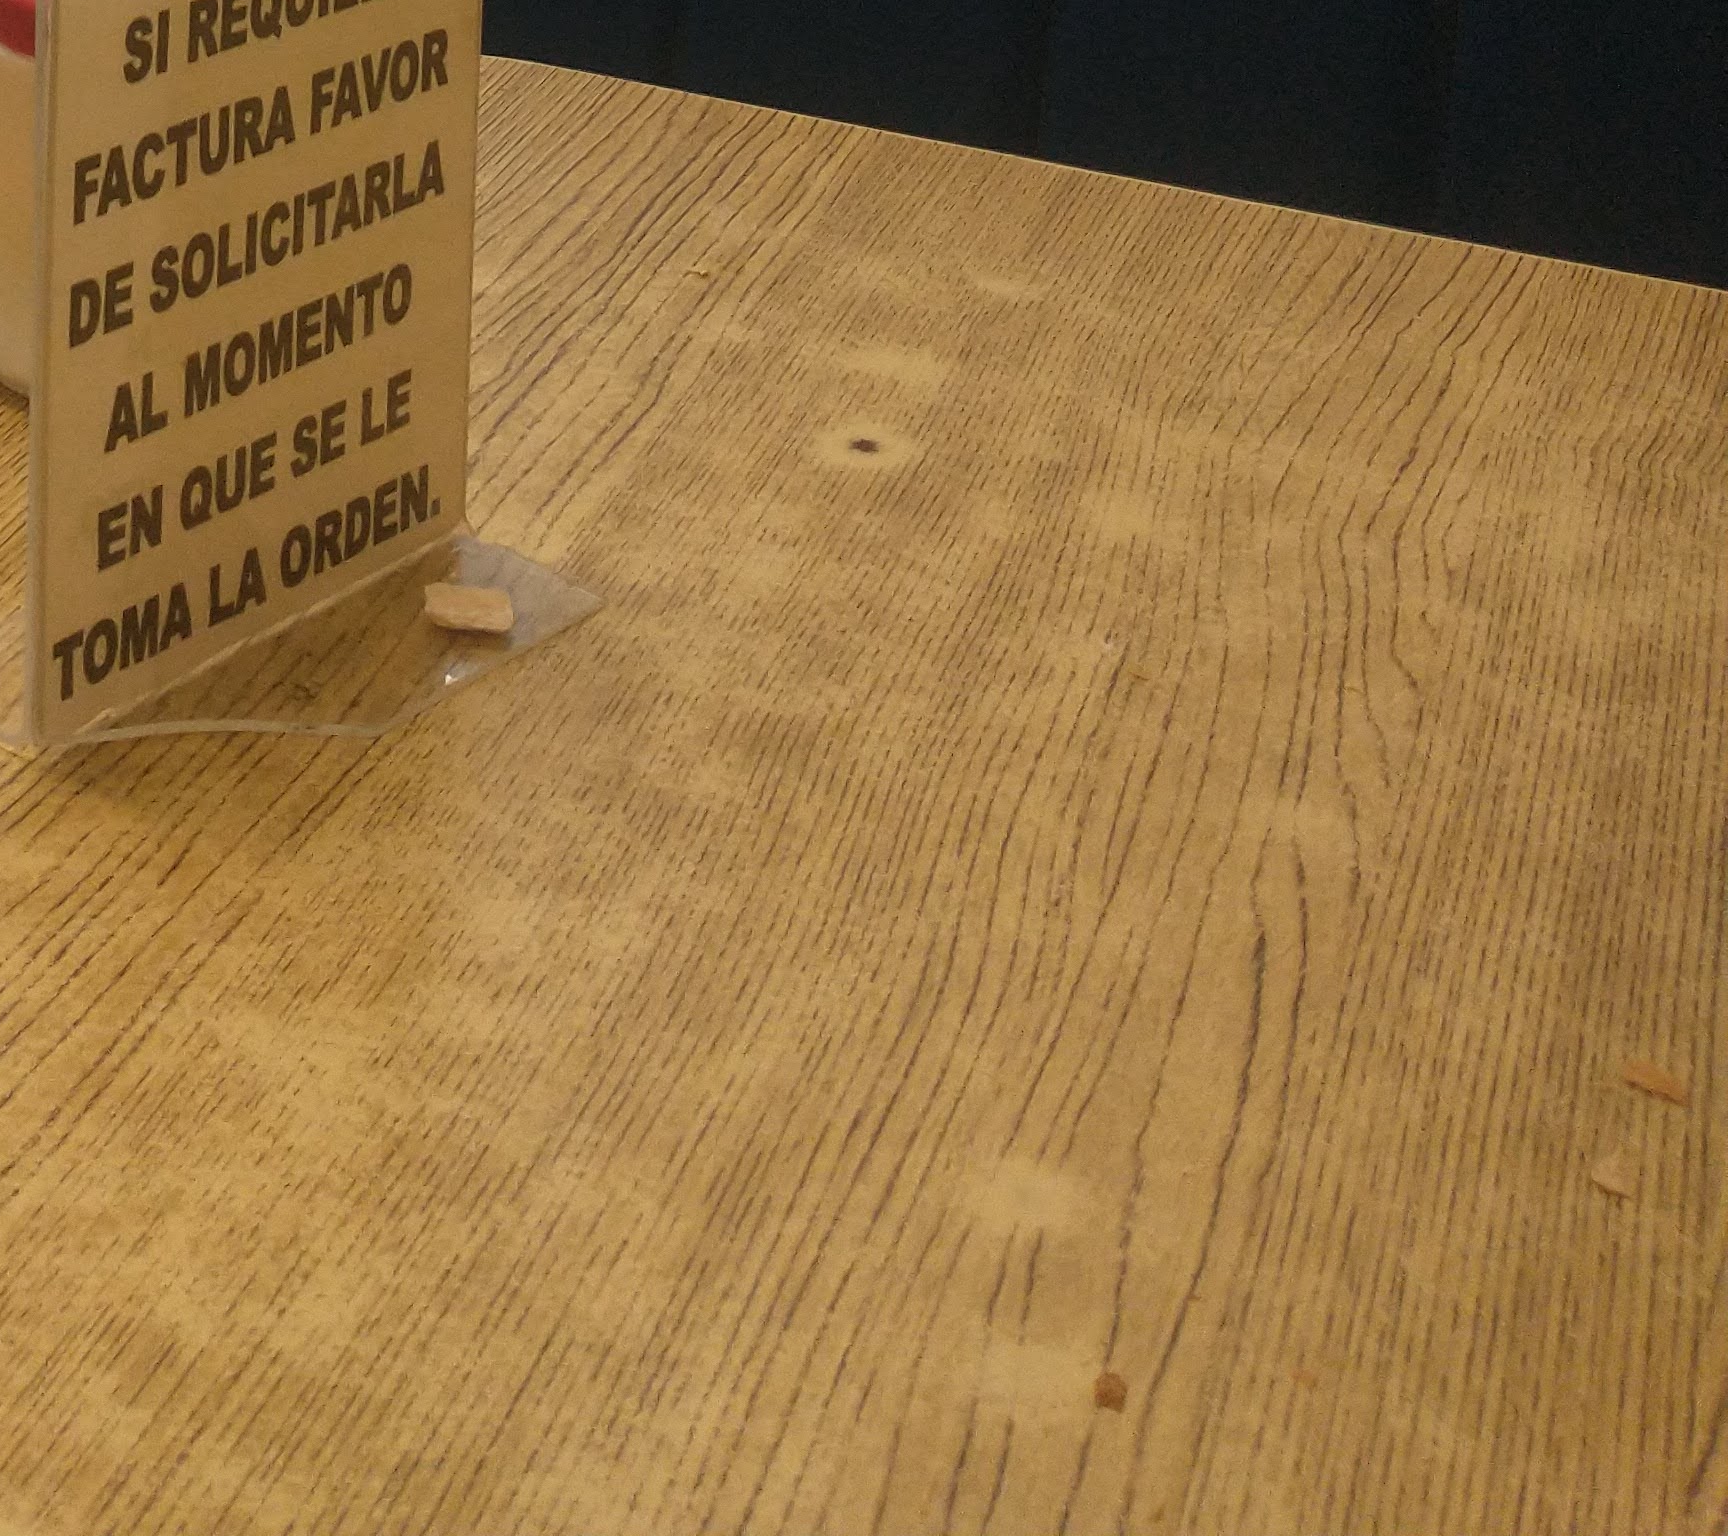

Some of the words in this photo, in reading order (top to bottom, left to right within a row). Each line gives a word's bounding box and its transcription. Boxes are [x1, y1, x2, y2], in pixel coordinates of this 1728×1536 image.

[73, 85, 296, 226] FACTURA
[310, 28, 449, 135] FAVOR
[123, 9, 169, 84] SI
[69, 261, 135, 350] DE
[150, 139, 445, 314] SOLICITARLA
[104, 371, 168, 454] AL
[184, 262, 413, 419] MOMENTO
[97, 483, 165, 572] EN
[179, 431, 278, 531] QUE
[290, 398, 347, 479] SE
[361, 368, 413, 448] LE
[52, 581, 193, 702] TOMA
[207, 546, 268, 628] LA
[279, 463, 442, 589] ORDEN.
